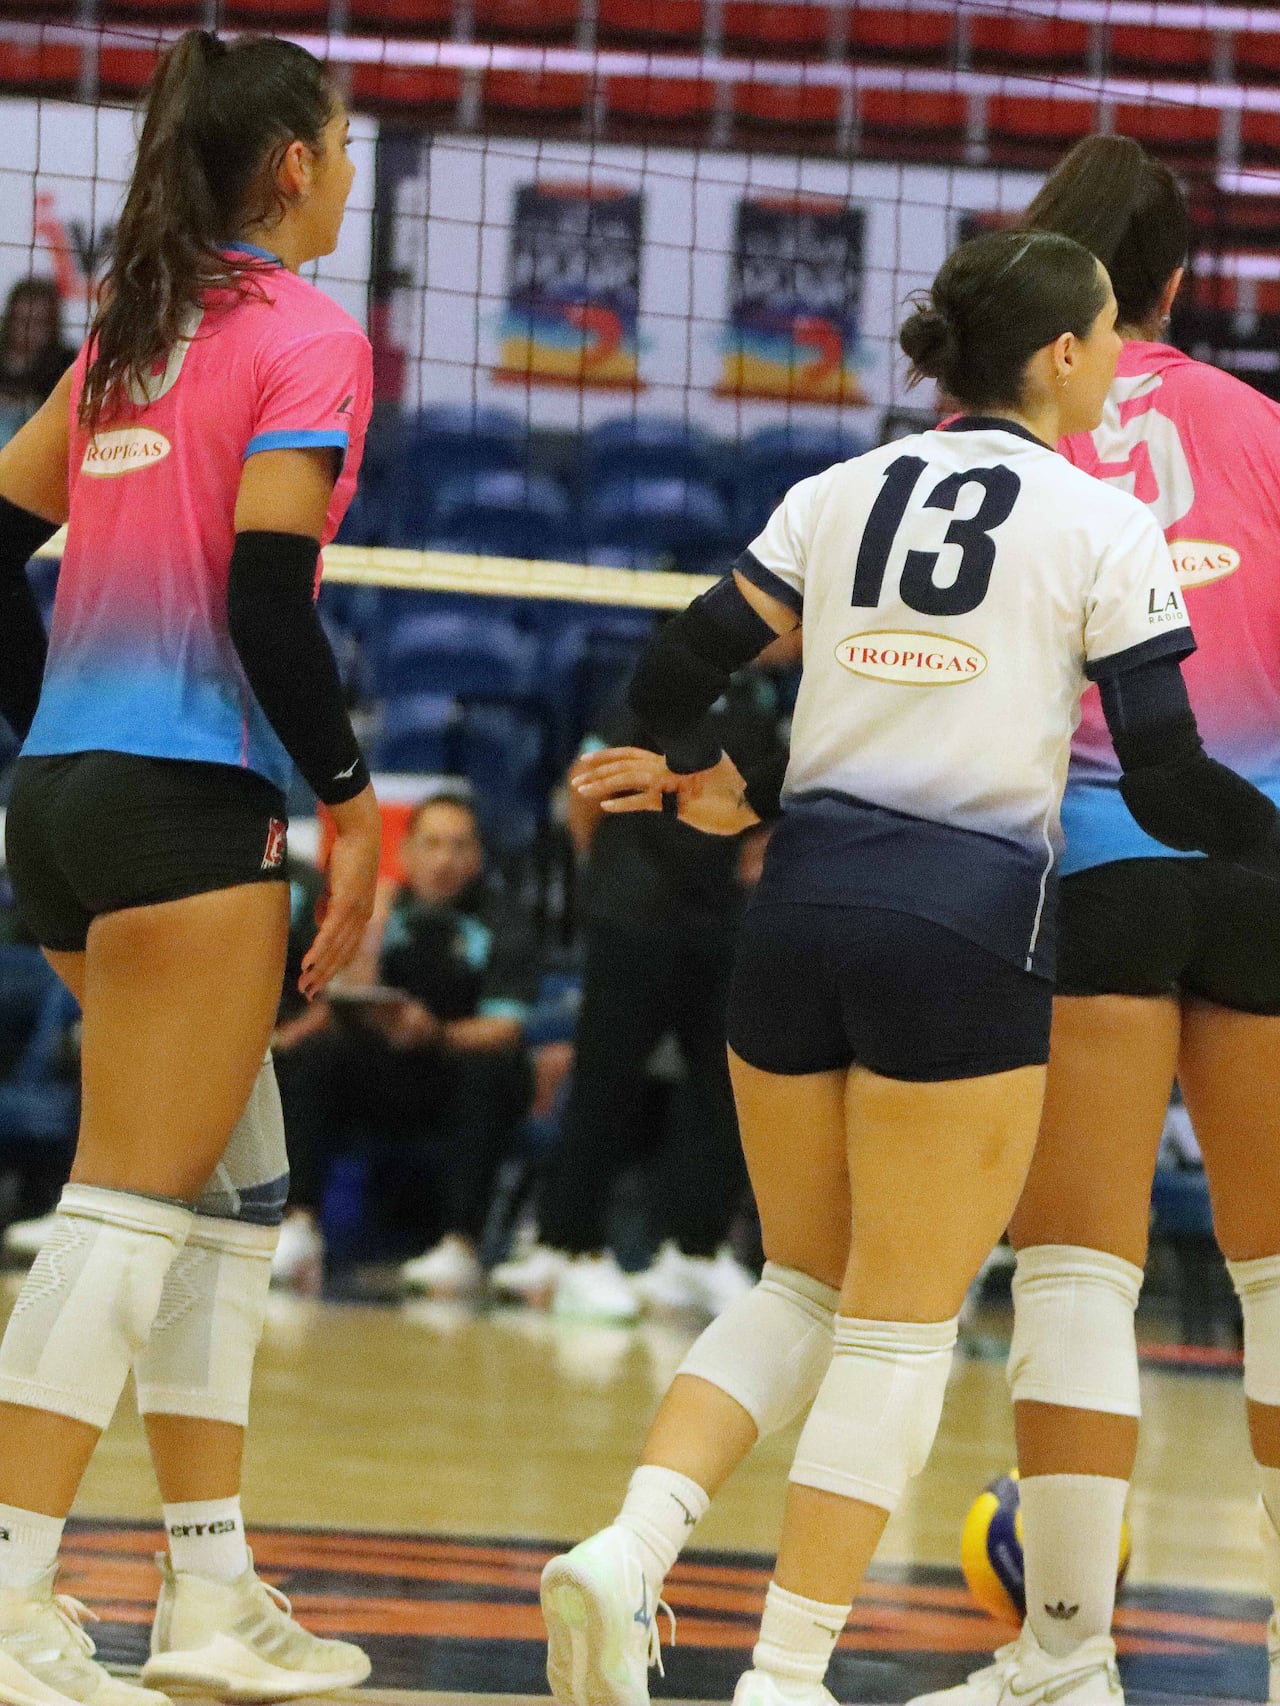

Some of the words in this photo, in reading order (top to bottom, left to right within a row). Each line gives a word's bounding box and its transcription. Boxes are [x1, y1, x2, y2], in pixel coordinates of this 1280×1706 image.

[86, 441, 164, 461] ROPIGAS
[850, 455, 1022, 617] 13
[1172, 553, 1231, 573] IGAS
[1148, 588, 1178, 614] LA
[1149, 611, 1184, 624] RADIO
[845, 646, 978, 673] TROPIGAS
